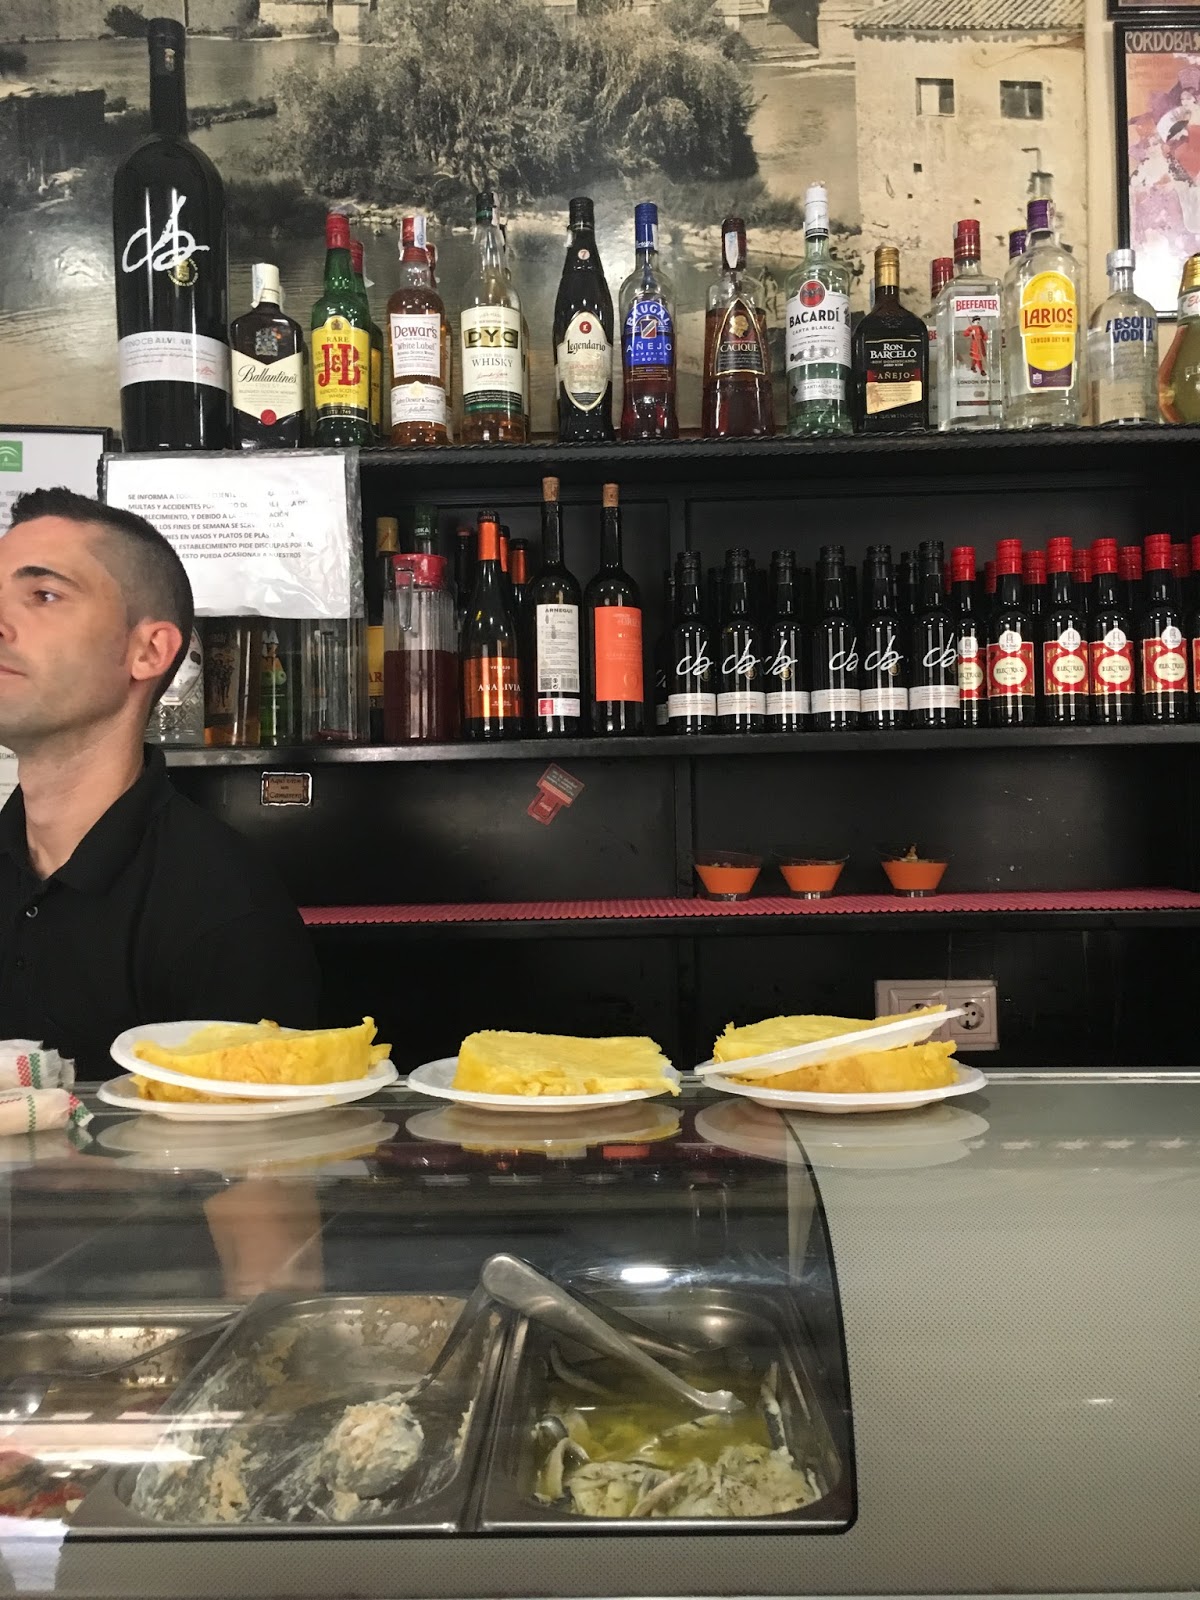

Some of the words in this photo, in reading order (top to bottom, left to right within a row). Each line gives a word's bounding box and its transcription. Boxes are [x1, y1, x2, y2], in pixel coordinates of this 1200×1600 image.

[956, 299, 998, 312] BEEFEATER
[626, 304, 671, 327] BRUGAL
[789, 307, 840, 328] BACARDÍ
[1024, 308, 1073, 329] LARIOS
[394, 325, 438, 339] Dewar's
[468, 329, 515, 344] DYC
[155, 337, 193, 345] ALVAR
[567, 339, 606, 354] Legendario
[626, 341, 672, 353] AÑEJO
[720, 343, 759, 352] CACIQUE
[883, 343, 903, 351] RON
[870, 348, 917, 359] BARCELÓ
[317, 343, 362, 387] J&B
[472, 358, 513, 367] WHISKY
[237, 364, 298, 384] Ballantine's
[477, 683, 521, 692] ANAIVIA
